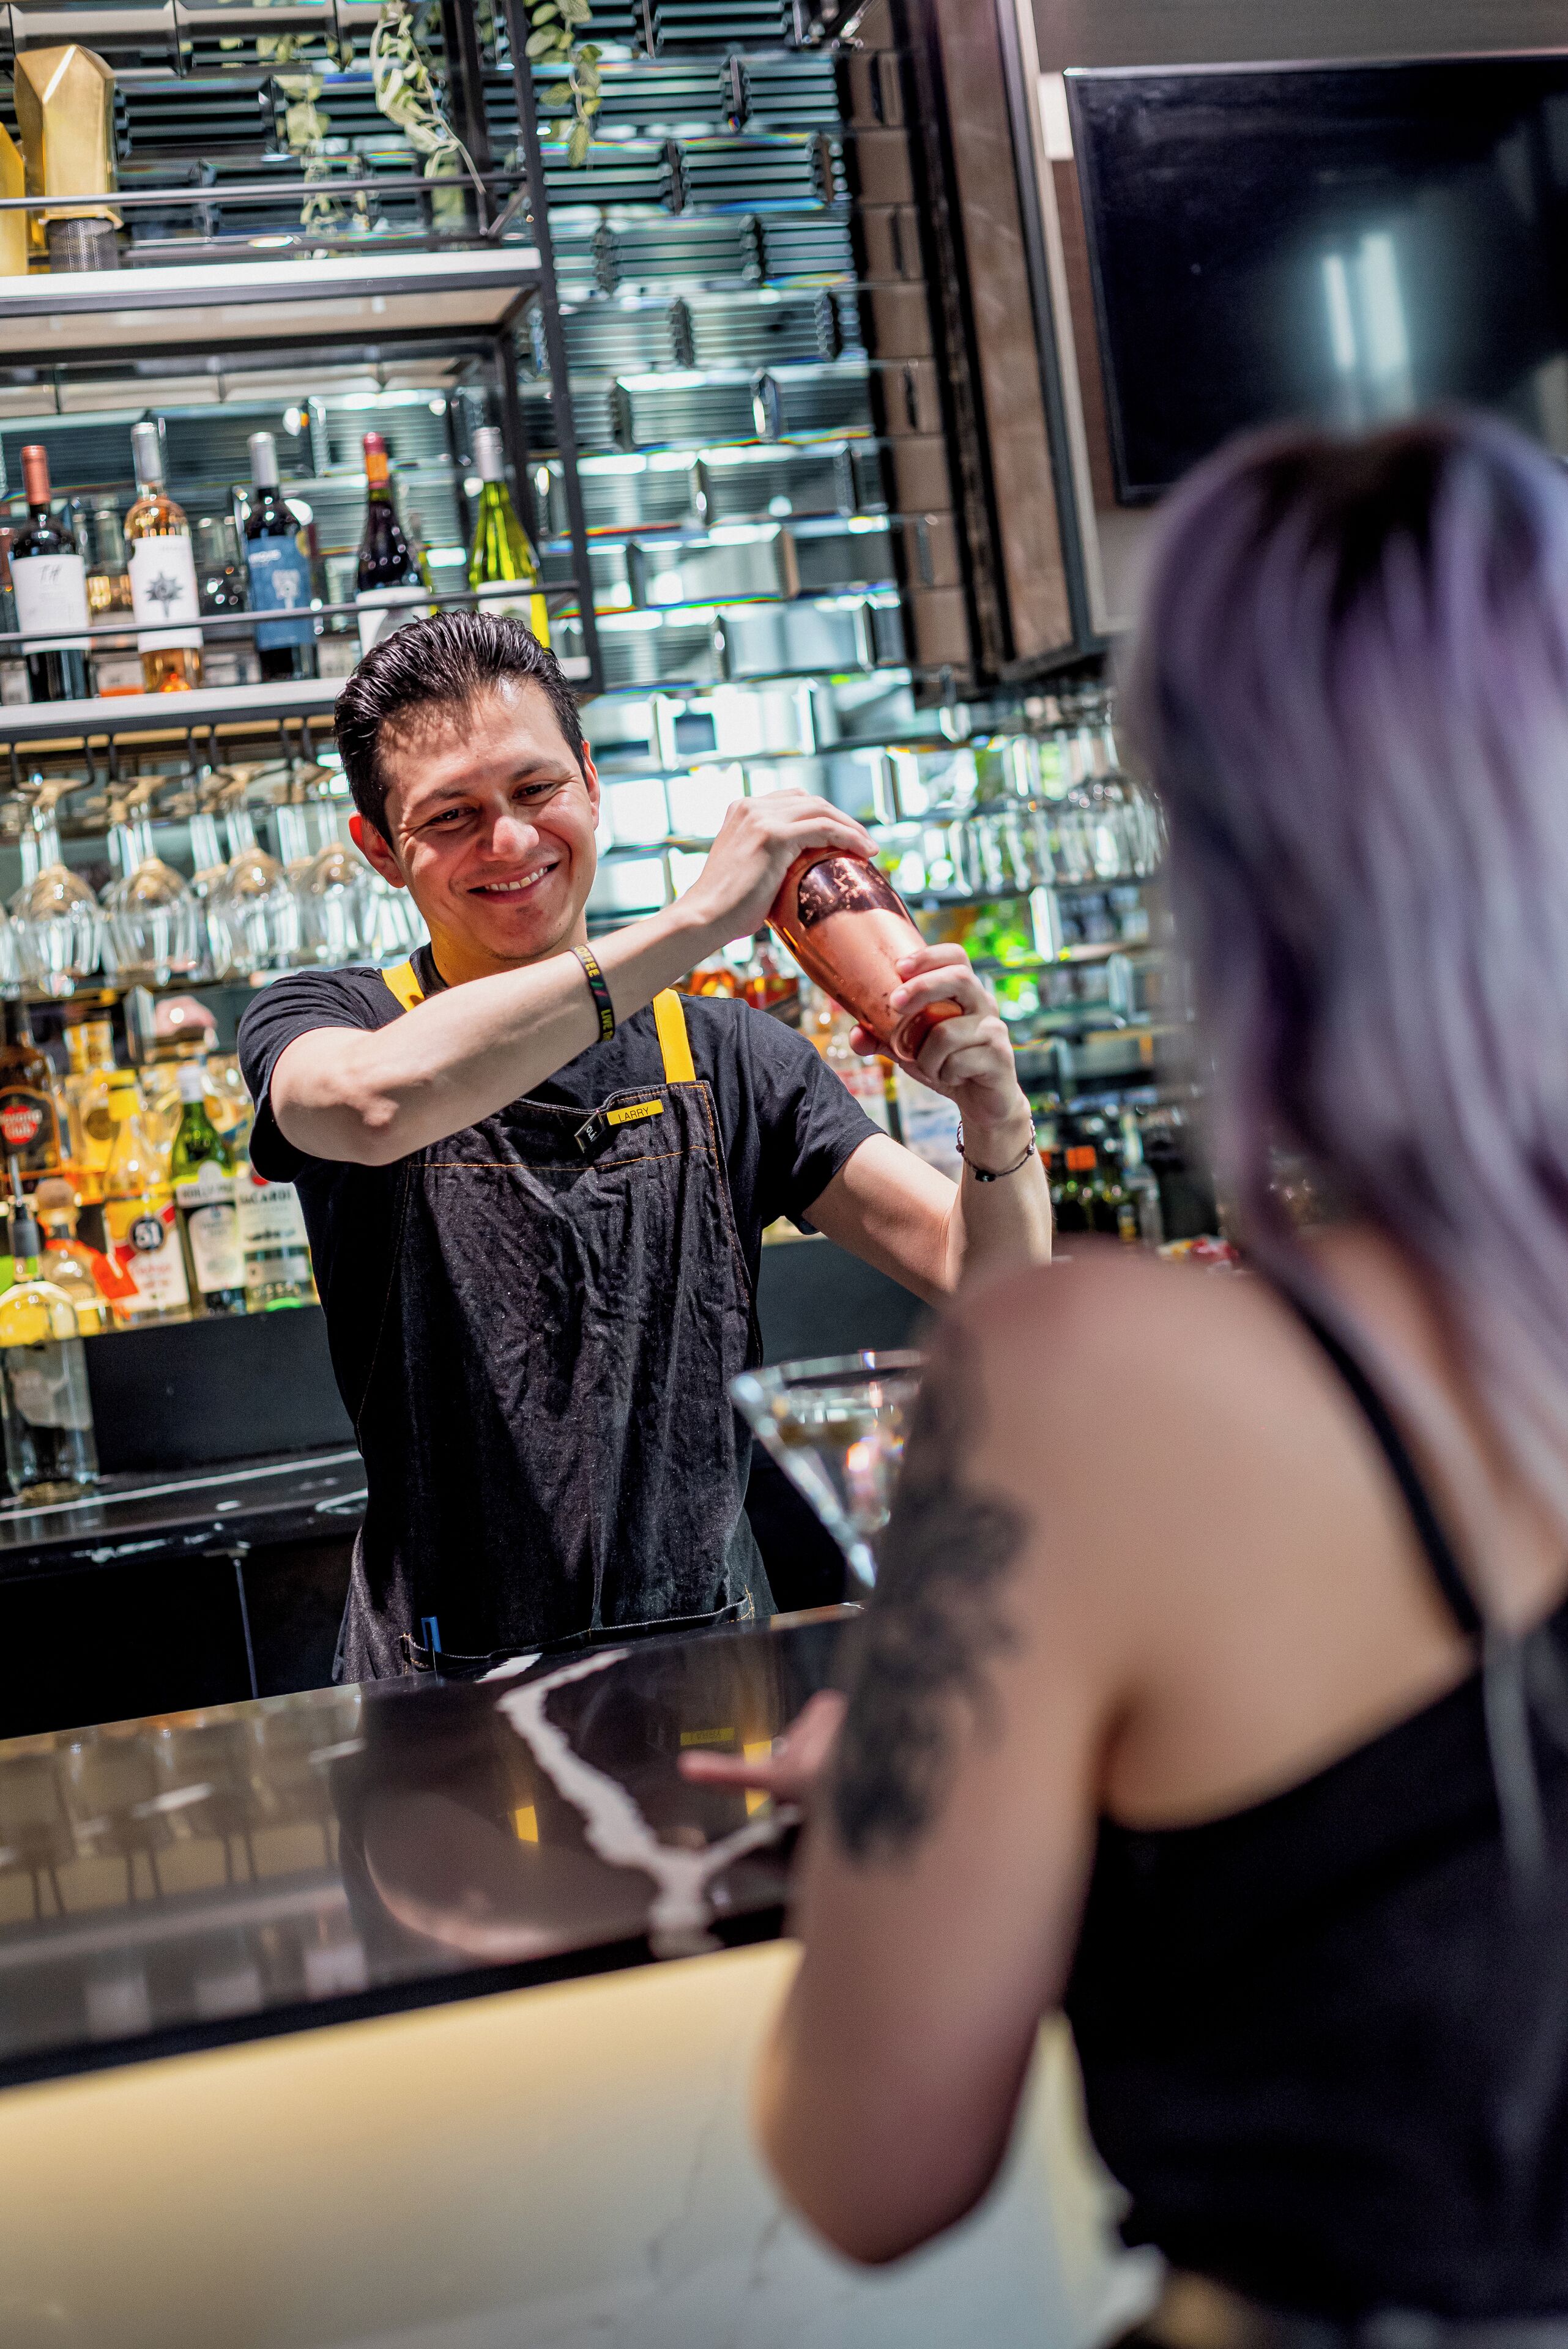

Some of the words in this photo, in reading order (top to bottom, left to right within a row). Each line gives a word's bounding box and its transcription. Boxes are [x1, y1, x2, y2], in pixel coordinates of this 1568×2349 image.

[601, 1009, 614, 1030] LIVE
[618, 1107, 648, 1122] LARRY
[135, 1222, 161, 1249] 51
